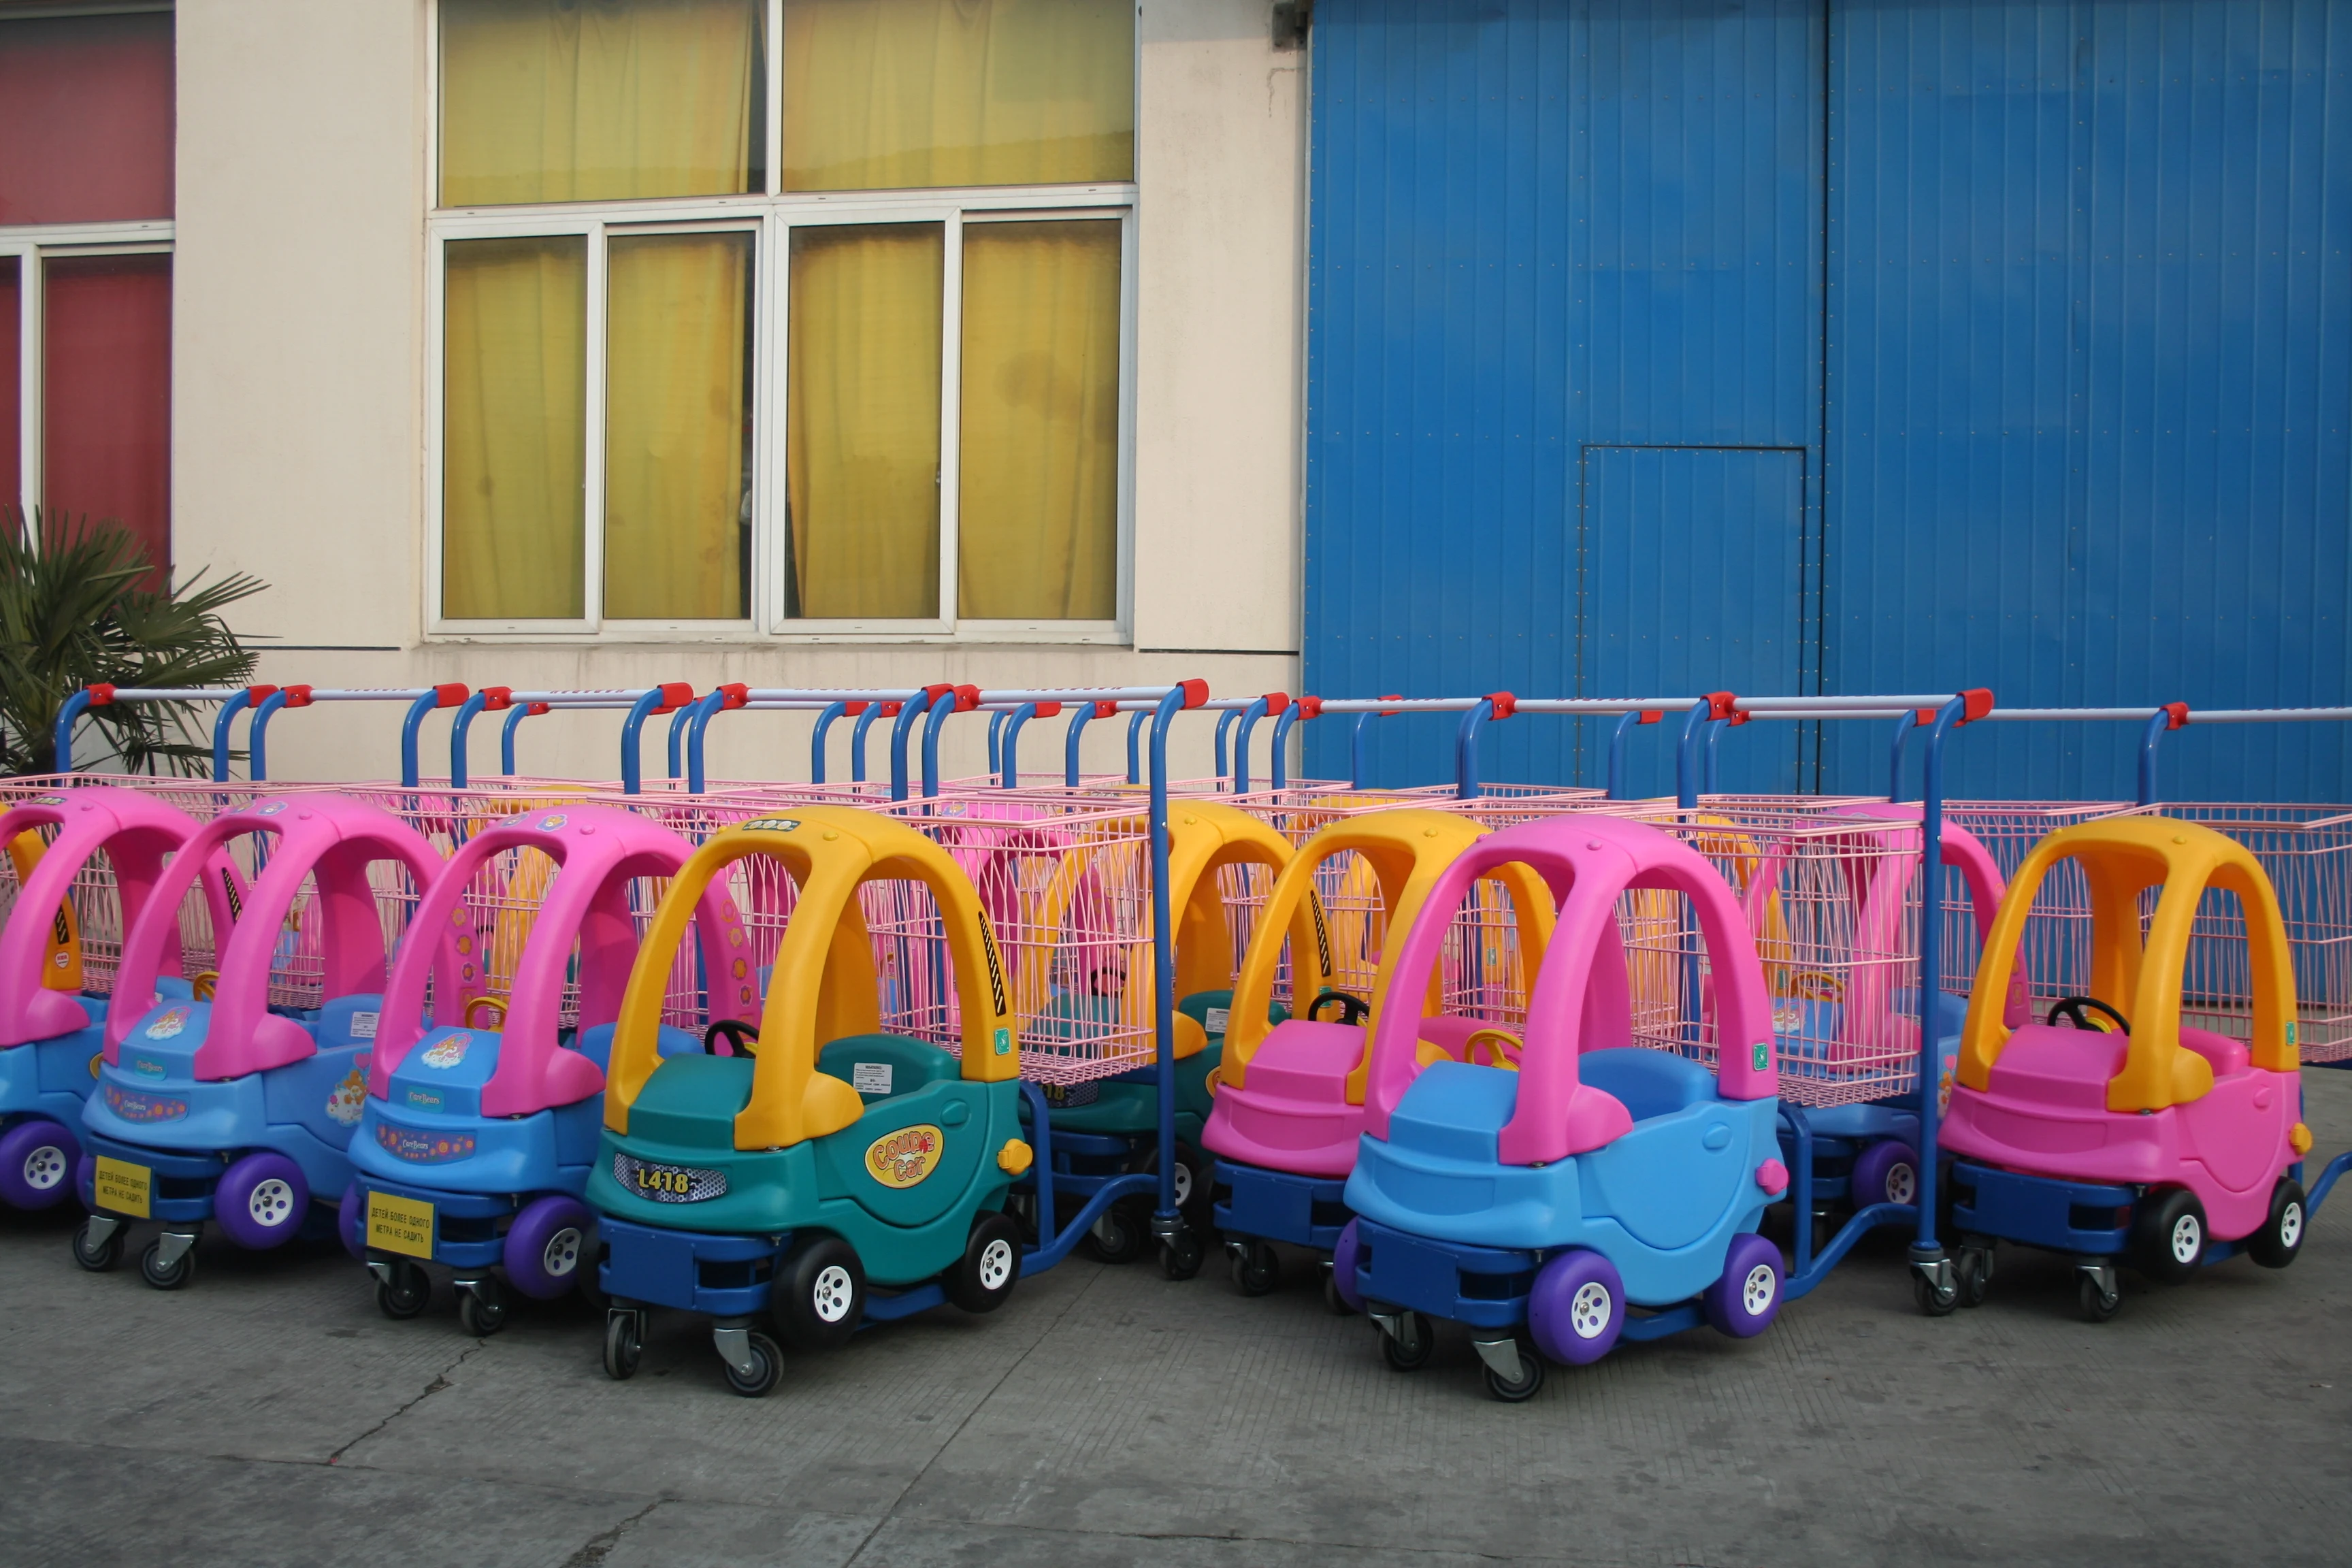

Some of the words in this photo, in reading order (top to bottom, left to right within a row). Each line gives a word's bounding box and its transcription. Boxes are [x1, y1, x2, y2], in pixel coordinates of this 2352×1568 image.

[1039, 1083, 1064, 1100] 18
[872, 1131, 935, 1170] Coupe
[894, 1156, 926, 1181] Car
[638, 1168, 689, 1194] L418
[372, 1207, 389, 1219] ДЕТЕЙ
[390, 1211, 407, 1224] БОЛЕЕ
[409, 1215, 430, 1229] ОДНОГО
[376, 1224, 393, 1235] МЕТРА
[395, 1228, 402, 1238] НЕ
[404, 1230, 424, 1243] САДИТЬ
